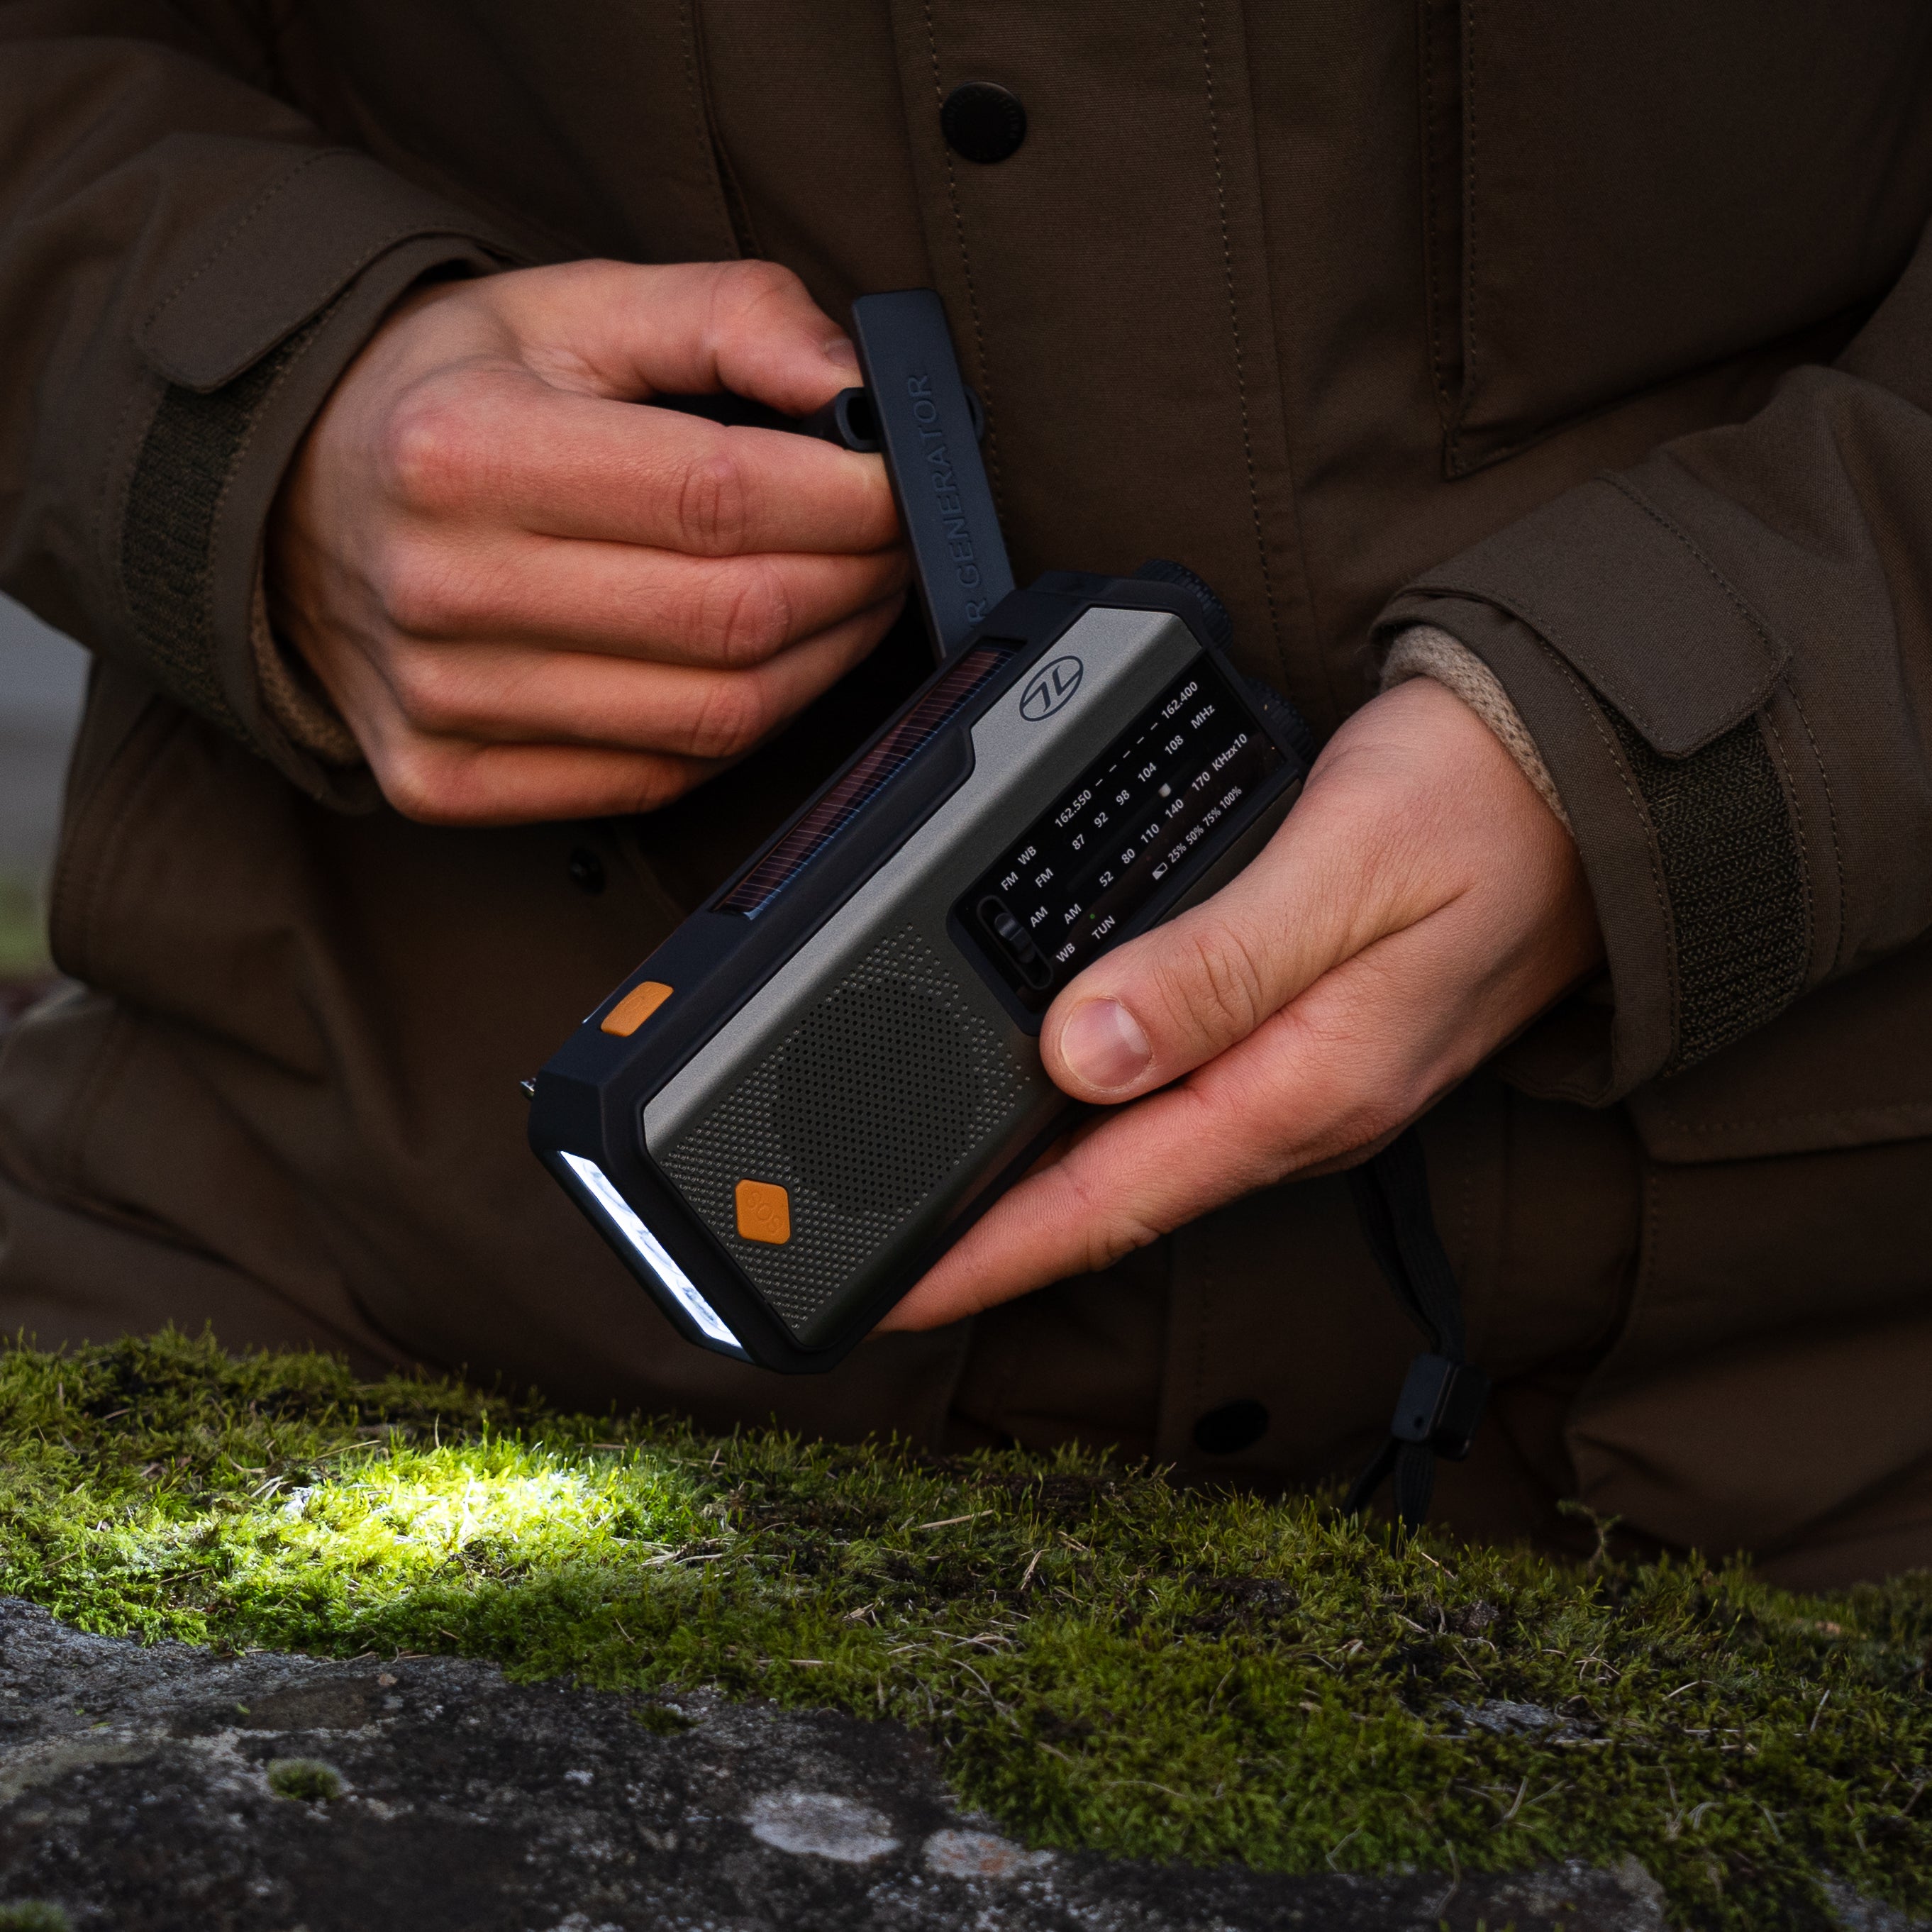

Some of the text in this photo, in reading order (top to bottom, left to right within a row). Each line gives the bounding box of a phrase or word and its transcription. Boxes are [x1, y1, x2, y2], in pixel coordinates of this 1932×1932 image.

[907, 374, 980, 588] GENERATOR
[1017, 681, 1199, 865] WB 162.550 162.400
[1035, 704, 1215, 888] FM 87 92 98 104 108 MHz
[1064, 733, 1248, 925] AM 52 80 110 140 170 KHzx10
[1167, 786, 1242, 863] 25% 50% 75% 100%
[1001, 871, 1018, 891] FM
[1030, 906, 1048, 928] AM
[1055, 943, 1075, 962] WB
[1091, 915, 1116, 940] TUN
